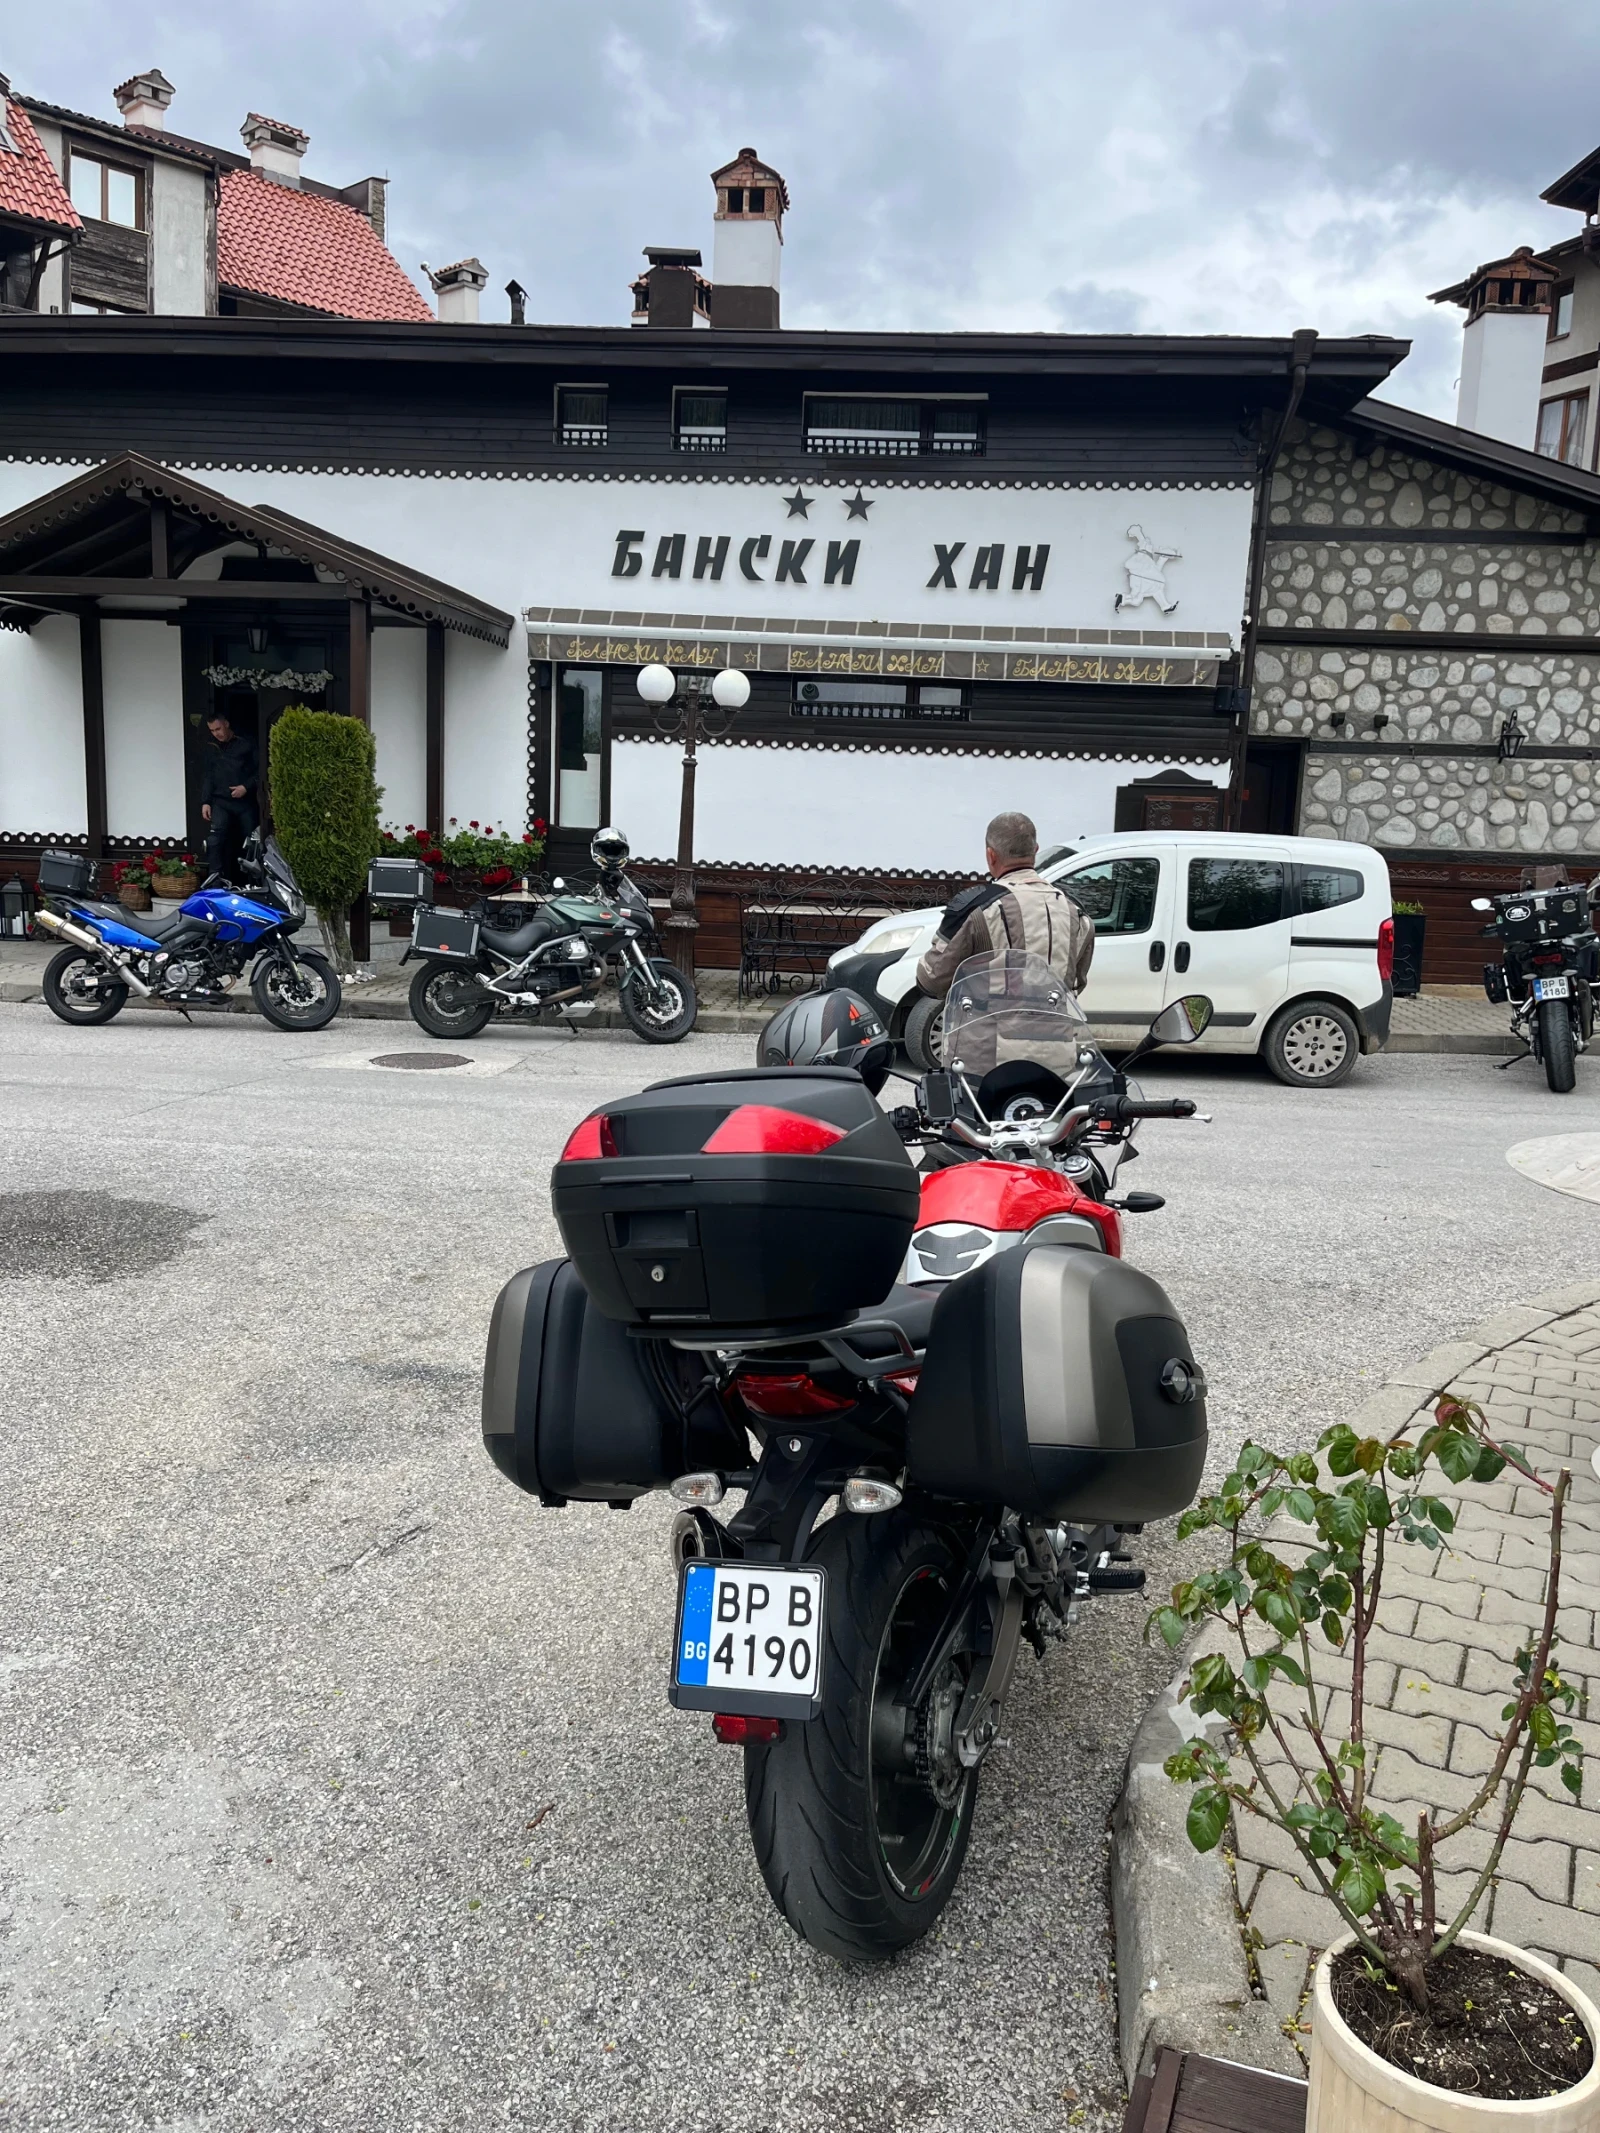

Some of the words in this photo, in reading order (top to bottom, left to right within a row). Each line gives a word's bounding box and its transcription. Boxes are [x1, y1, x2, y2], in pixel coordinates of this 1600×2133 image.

[610, 529, 862, 586] БАНСКИ
[925, 541, 1052, 592] ХАН
[566, 639, 660, 662] БАНСКИ
[662, 643, 719, 665] ХАН
[788, 650, 883, 671] БАНСКИ
[886, 654, 944, 674] ХАН
[1012, 658, 1110, 679] БАНСКИ
[1113, 662, 1173, 682] ХАН
[716, 1581, 770, 1624] BP
[787, 1585, 813, 1627] B
[684, 1640, 707, 1660] BG
[713, 1632, 811, 1680] 4190
